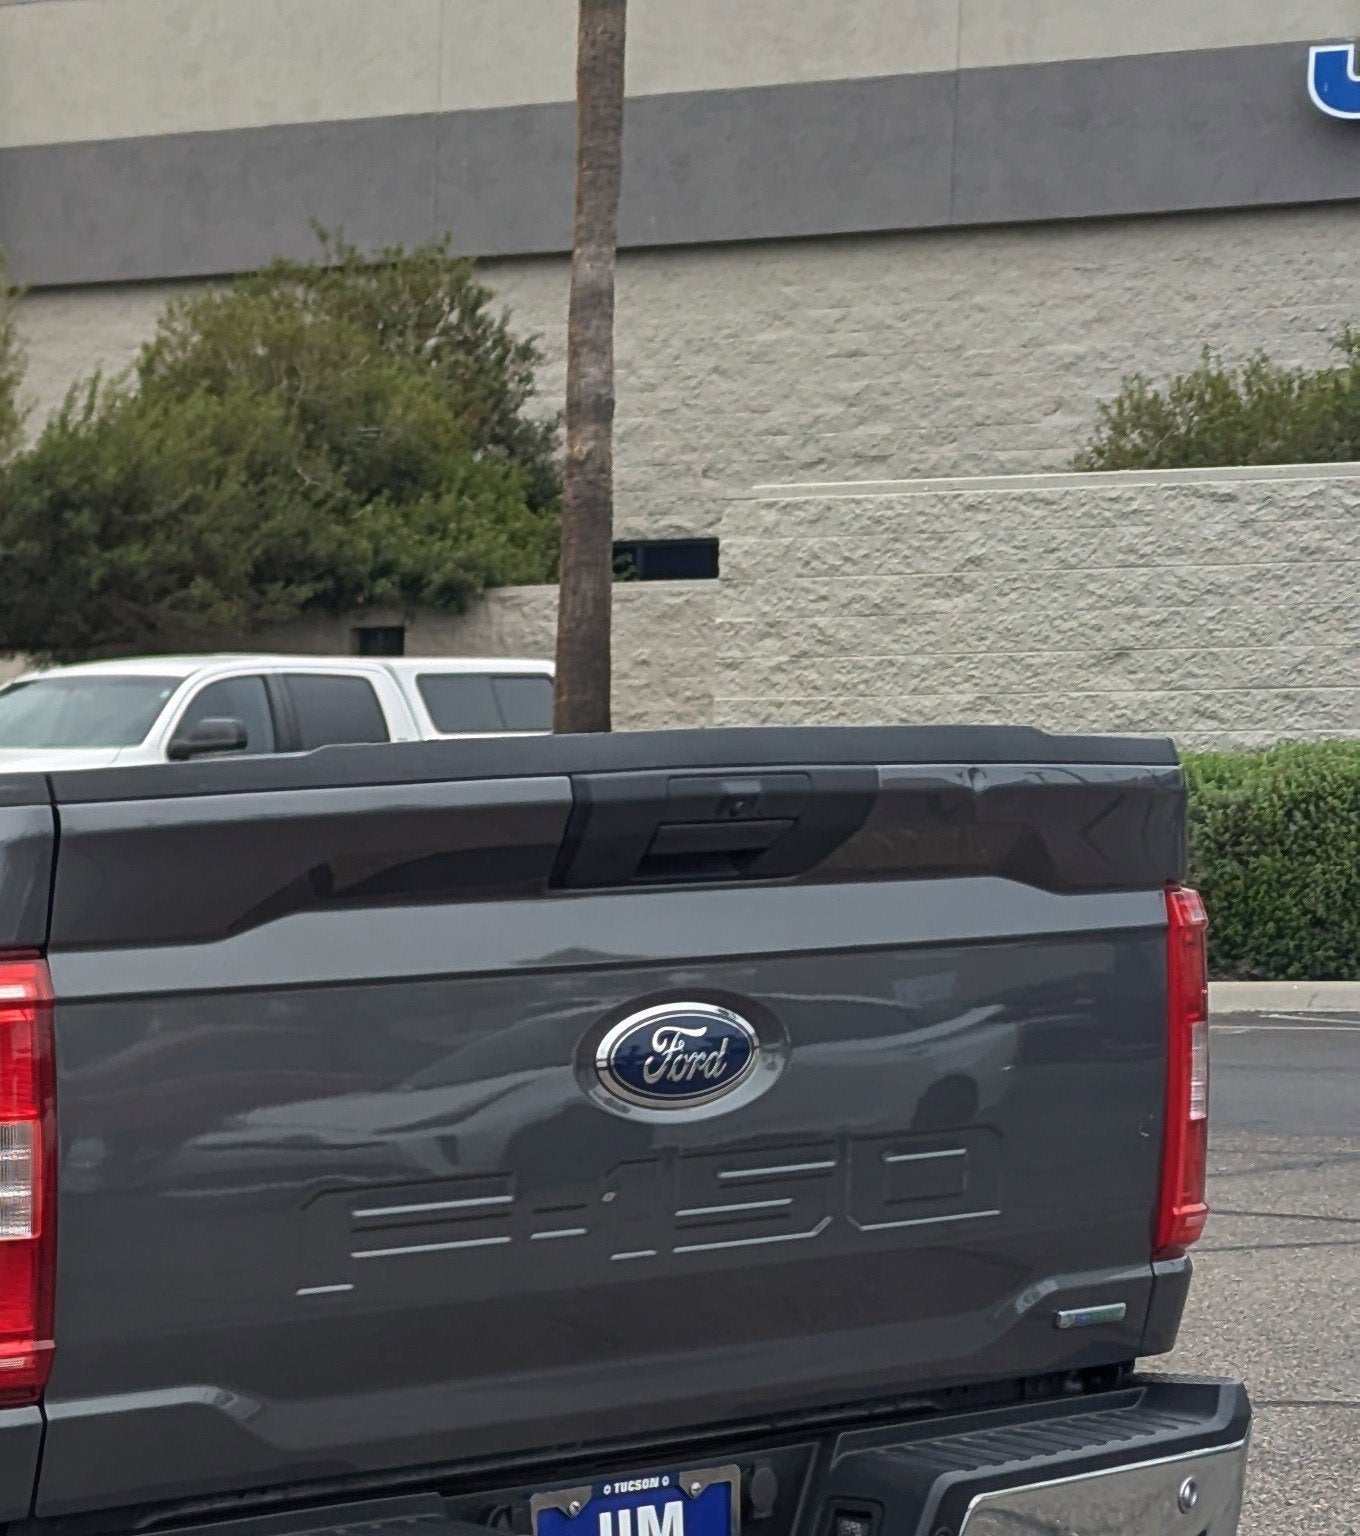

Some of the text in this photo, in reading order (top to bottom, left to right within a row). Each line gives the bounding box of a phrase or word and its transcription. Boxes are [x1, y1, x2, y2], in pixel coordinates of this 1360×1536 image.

[643, 1026, 729, 1084] Ford
[296, 1122, 1005, 1296] F-150
[613, 1476, 660, 1494] TUCSON
